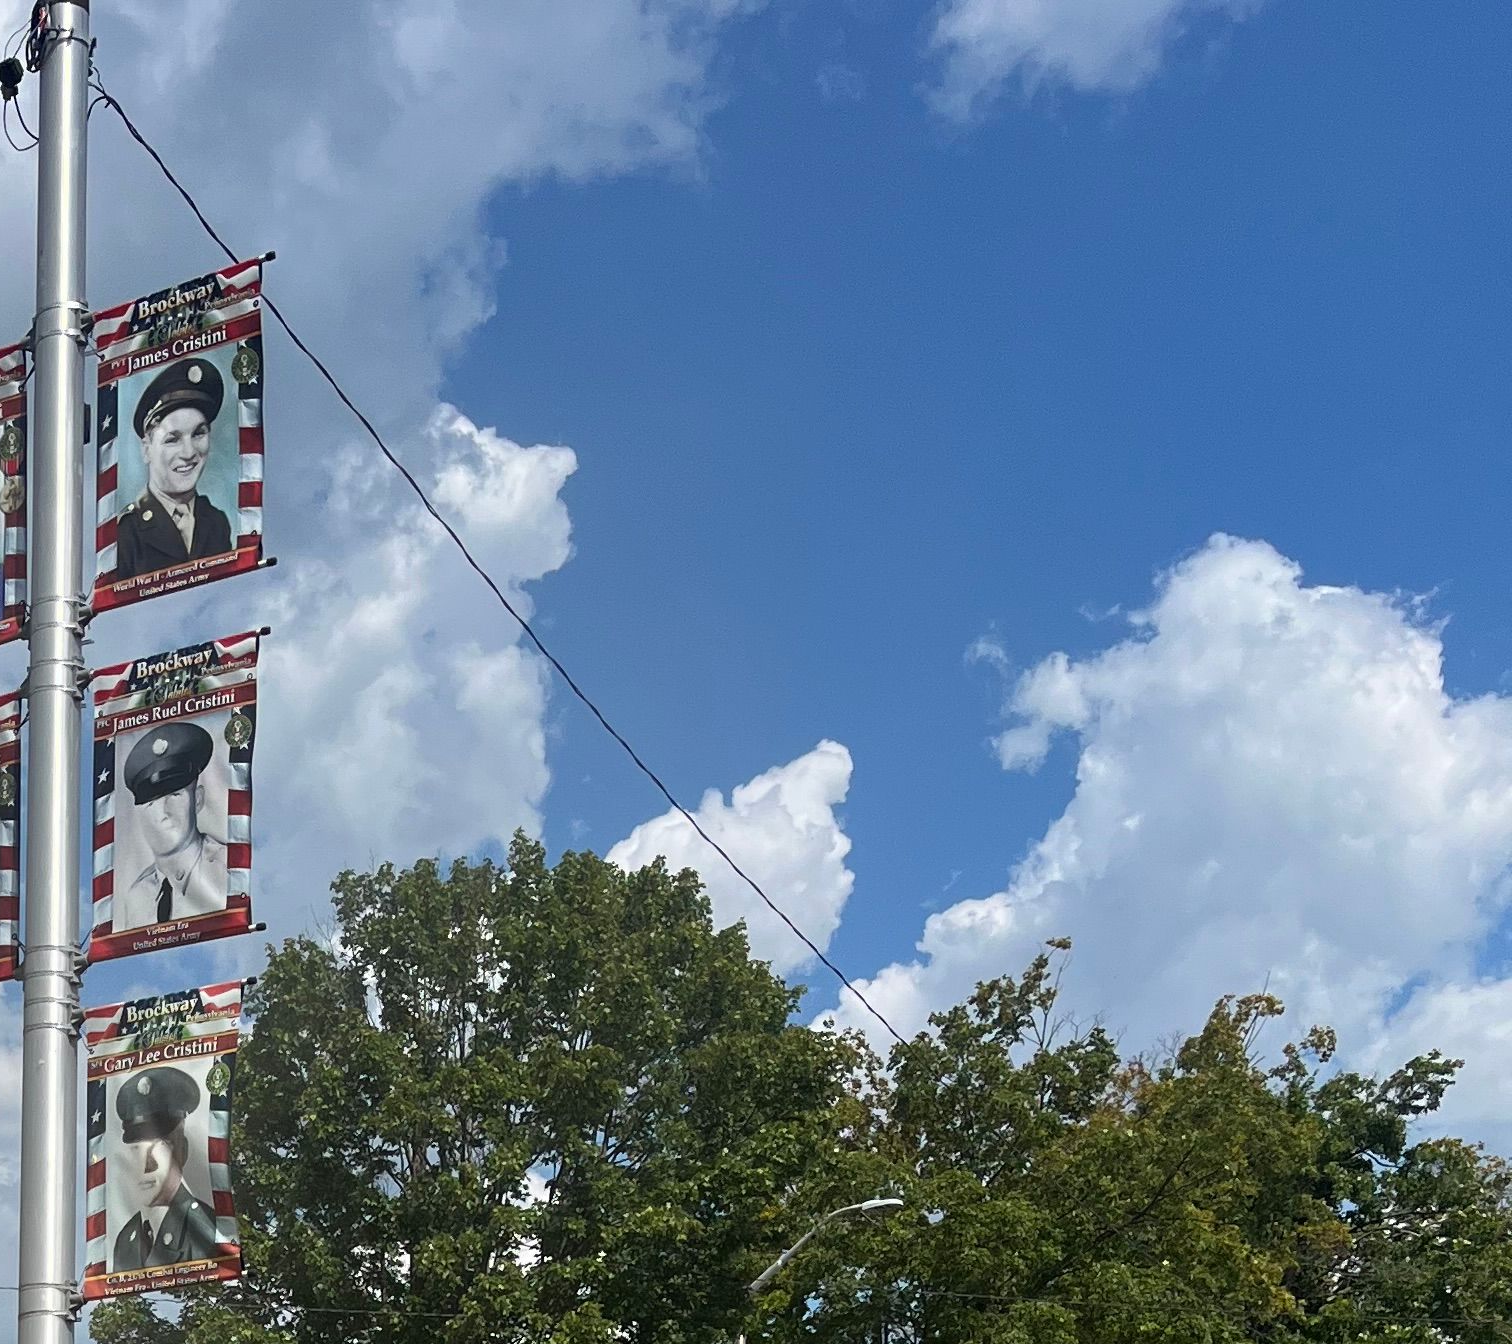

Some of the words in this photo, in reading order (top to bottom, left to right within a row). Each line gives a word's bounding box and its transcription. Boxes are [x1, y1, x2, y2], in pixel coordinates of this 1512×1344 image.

[139, 281, 215, 319] Brockway
[204, 288, 256, 310] Pennsylvania
[111, 359, 127, 370] PVT
[127, 347, 169, 376] James
[173, 324, 227, 355] Cristini
[113, 580, 136, 593] World
[137, 576, 151, 586] War
[153, 572, 160, 582] II
[166, 562, 198, 578] Armored
[200, 552, 238, 570] Command
[139, 582, 164, 597] United
[165, 577, 188, 590] States
[189, 572, 210, 585] Army
[137, 649, 213, 679] Brockway
[201, 657, 252, 676] Pennsylvania
[112, 712, 149, 736] James
[153, 701, 181, 720] Ruel
[185, 689, 236, 713] Cristini
[133, 938, 157, 951] United
[158, 936, 179, 946] States
[181, 931, 201, 943] Army
[146, 925, 176, 937] Vietnam
[177, 921, 189, 931] Era
[127, 997, 199, 1024] Brockway
[186, 1008, 235, 1023] Pennsylvania
[104, 1056, 135, 1073] Gary
[139, 1050, 161, 1065] Lee
[164, 1037, 218, 1060] Cristini
[146, 1269, 173, 1279] Combat
[174, 1263, 206, 1274] Engineer
[105, 1285, 133, 1295] Vietnam
[135, 1283, 146, 1291] Era
[152, 1279, 175, 1289] United
